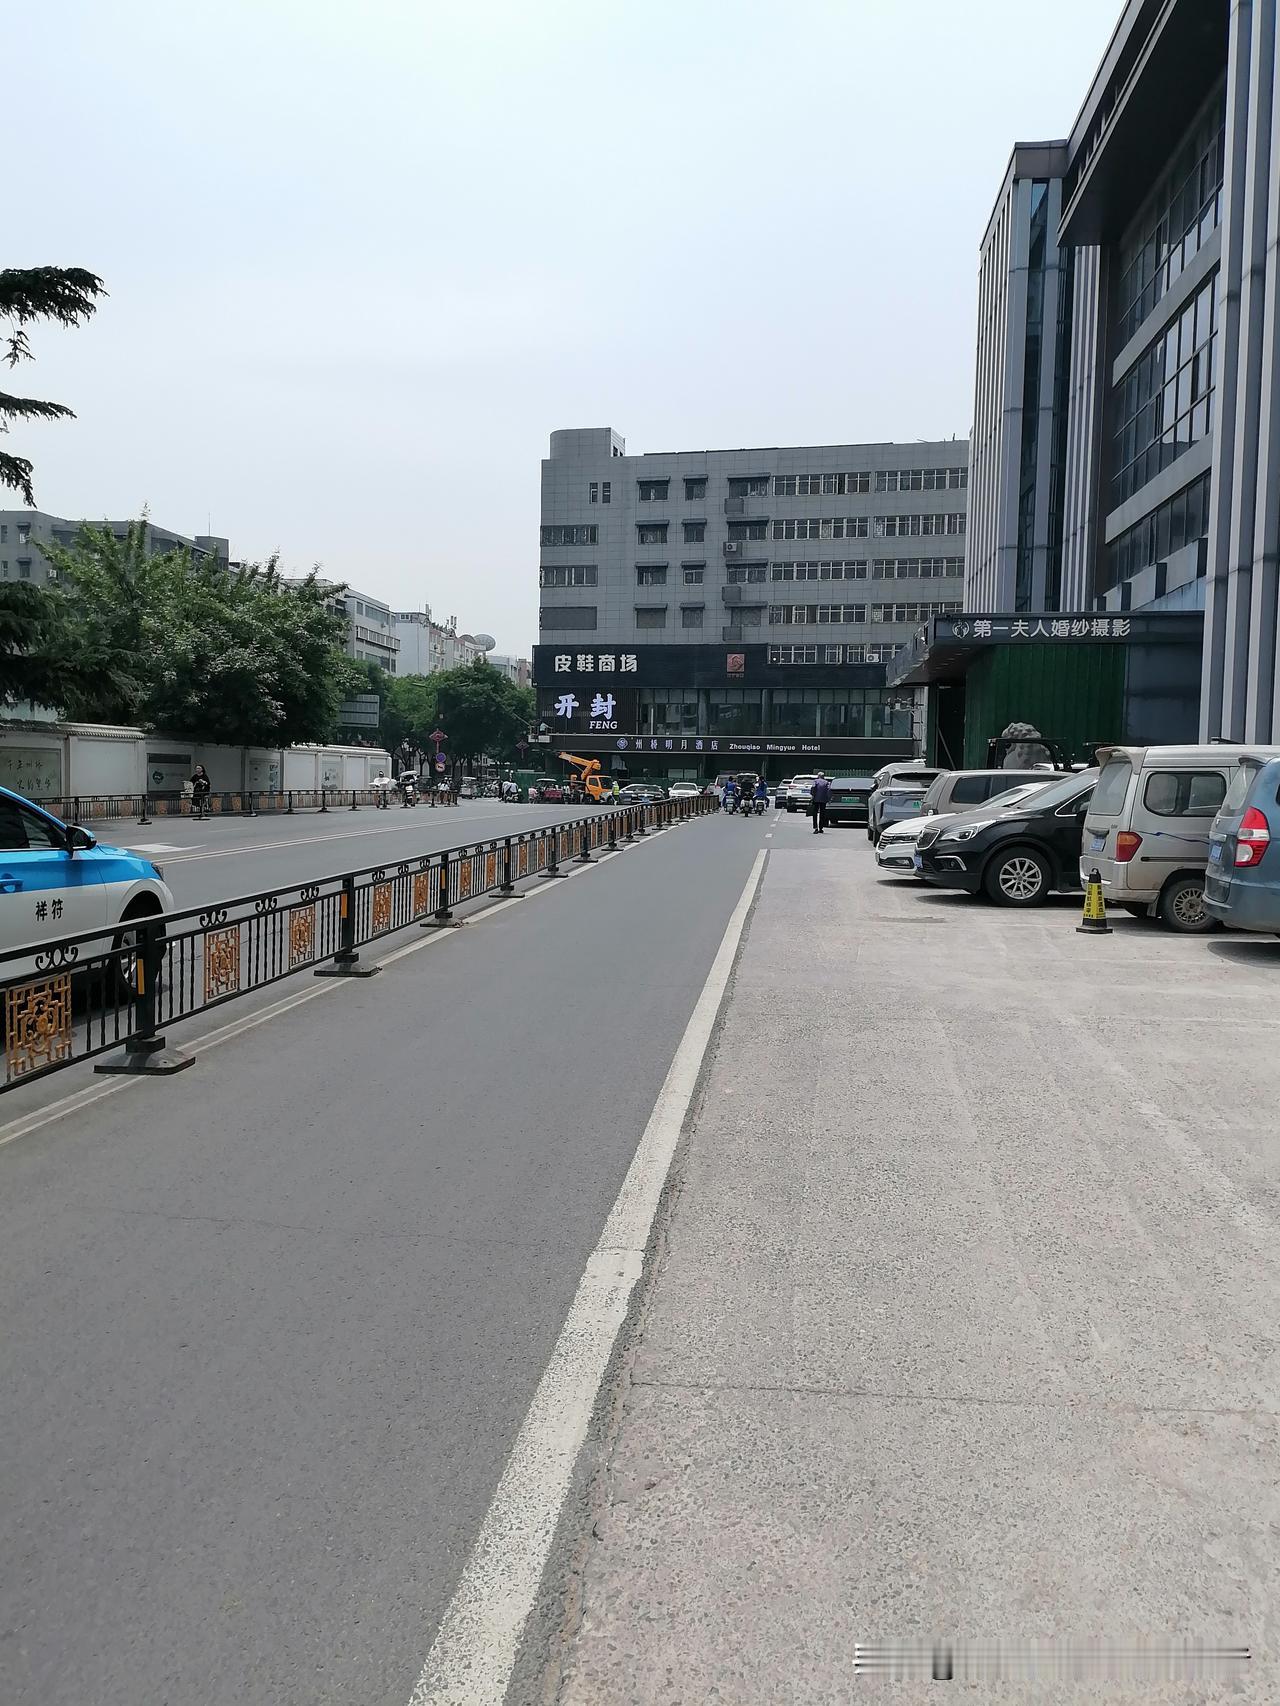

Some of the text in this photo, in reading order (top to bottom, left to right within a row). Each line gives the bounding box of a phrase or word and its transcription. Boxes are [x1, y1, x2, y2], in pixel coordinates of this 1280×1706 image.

[973, 619, 1130, 638] 第一夫人婚纱摄影
[554, 654, 638, 672] 皮鞋商场
[554, 693, 617, 720] 开封
[589, 721, 618, 730] FENG
[729, 743, 821, 752] Zhouqiao Mingyue Hotel
[35, 899, 64, 922] 祥符
